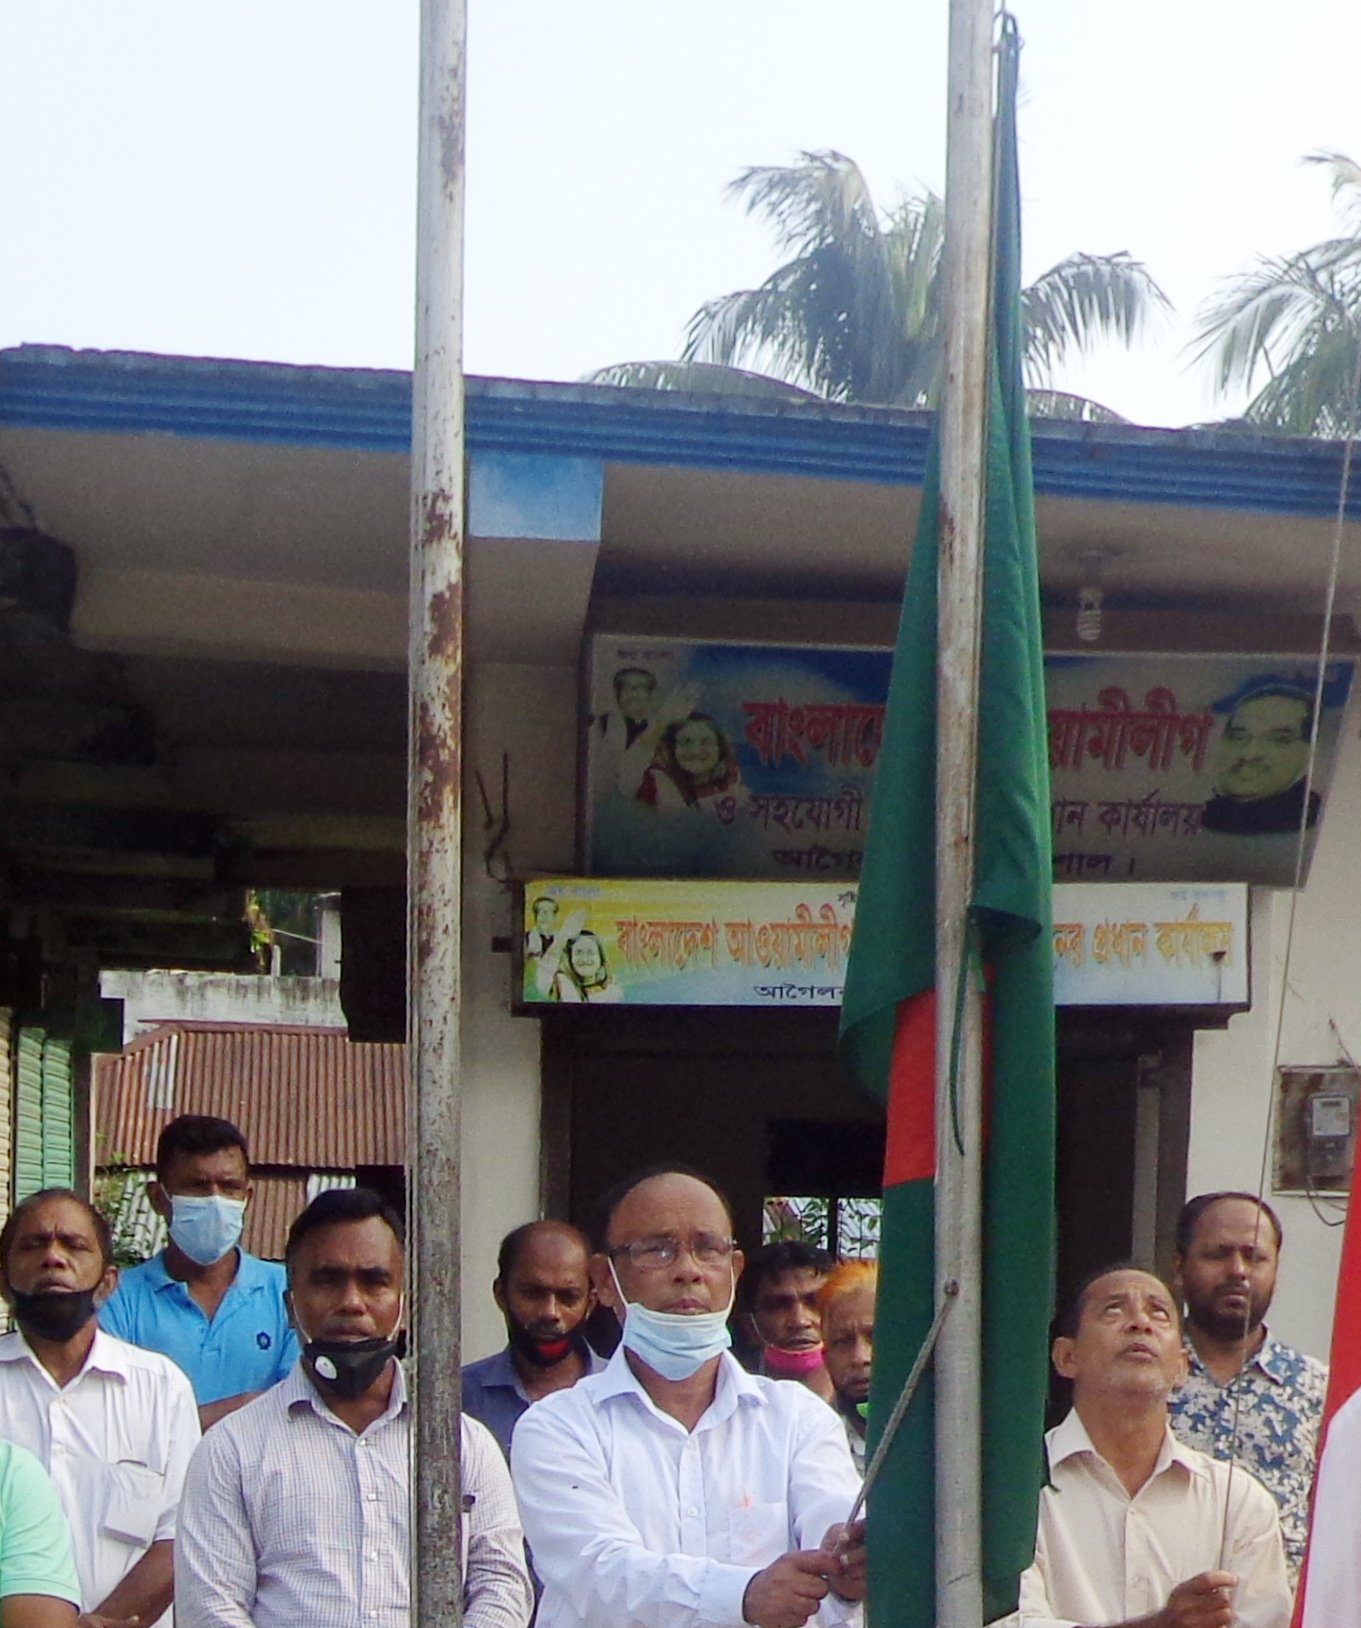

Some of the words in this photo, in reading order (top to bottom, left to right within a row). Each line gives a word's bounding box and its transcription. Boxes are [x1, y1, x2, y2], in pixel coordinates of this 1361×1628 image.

[1049, 686, 1215, 770] য়ামীলীগ
[748, 783, 862, 833] সহযোগী
[615, 916, 719, 971] বাংলাদেশ
[1093, 918, 1147, 968] প্রধান
[754, 982, 844, 1001] আগৈল
